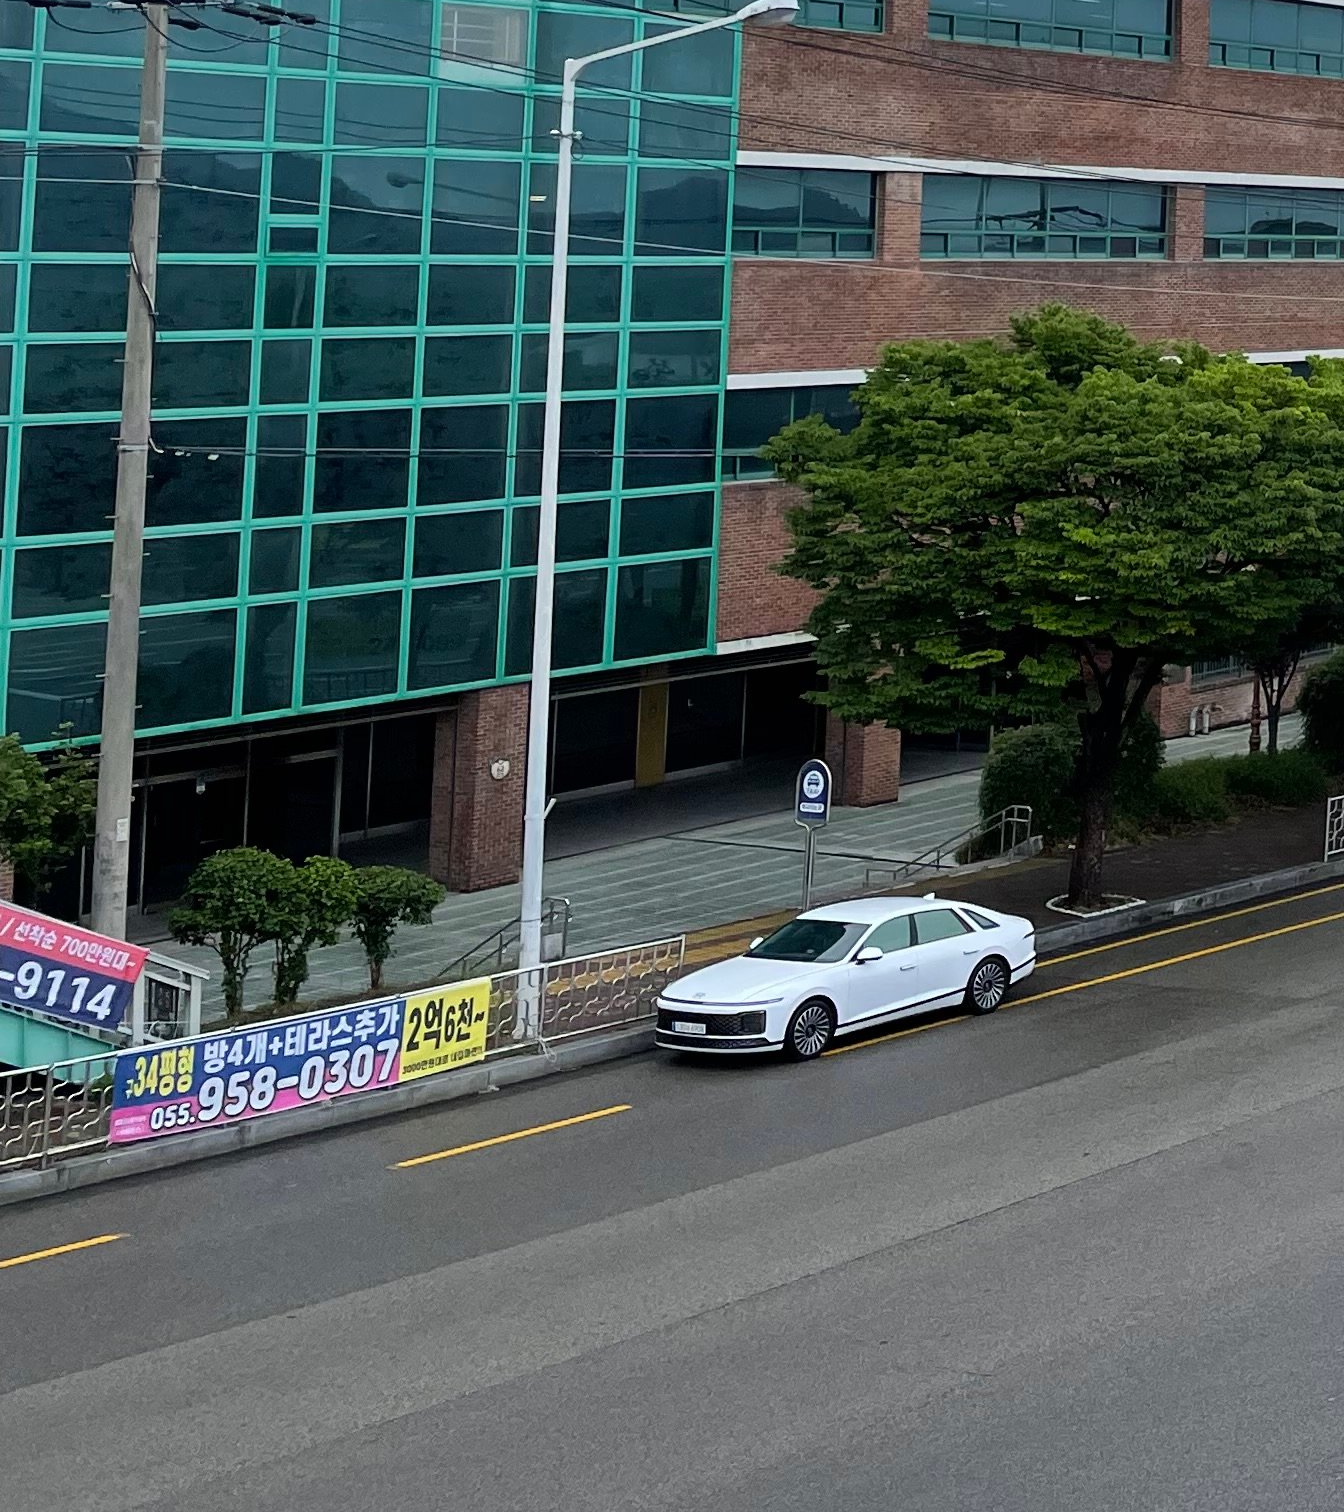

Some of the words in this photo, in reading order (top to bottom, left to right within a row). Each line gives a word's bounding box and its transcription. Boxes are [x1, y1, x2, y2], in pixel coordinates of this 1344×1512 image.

[13, 921, 58, 950] 선착순
[203, 1003, 400, 1075] 방4개+테라스추가
[406, 996, 486, 1052] 2억6천~
